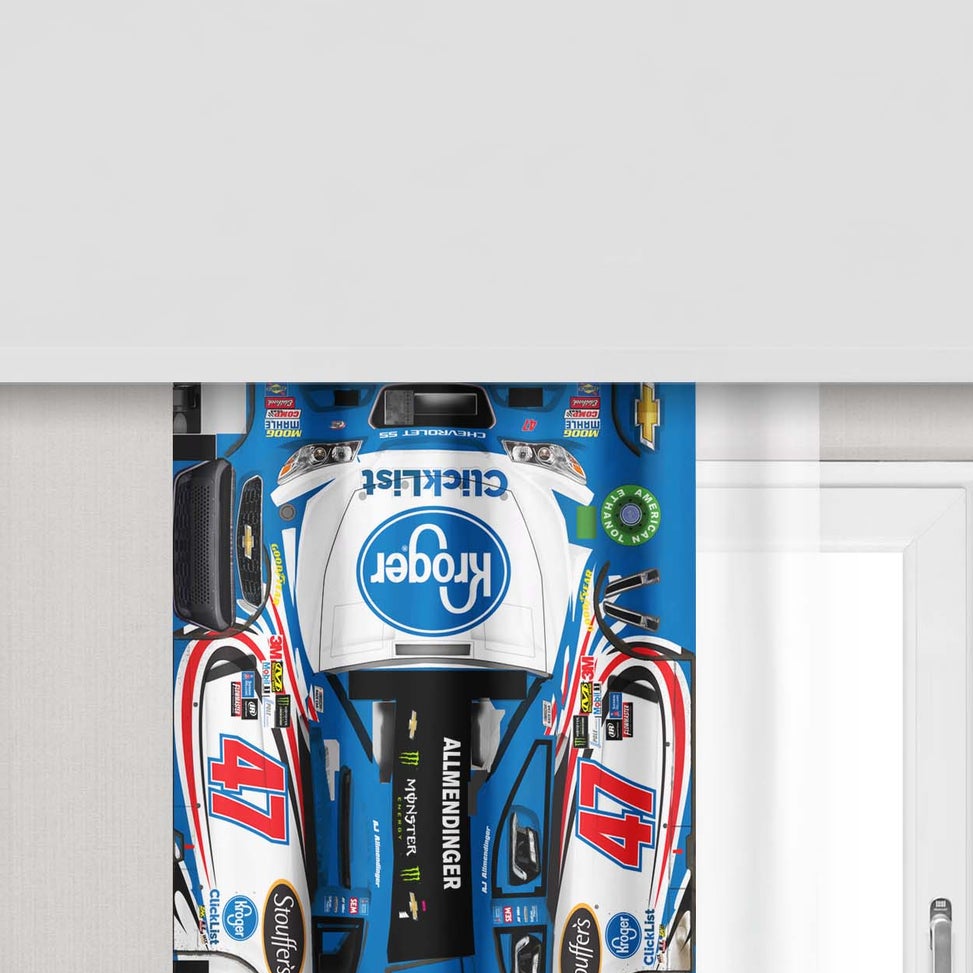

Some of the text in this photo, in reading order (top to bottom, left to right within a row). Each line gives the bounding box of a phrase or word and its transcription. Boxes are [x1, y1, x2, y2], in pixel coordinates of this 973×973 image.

[266, 421, 299, 429] MAHLE
[266, 429, 302, 437] MOOG
[379, 430, 486, 439] CHEVROLET SS
[522, 419, 537, 432] 47
[566, 421, 599, 429] MAHLE
[361, 469, 508, 497] ClickList
[604, 489, 659, 543] AMERICAN ETHANOL
[371, 523, 491, 614] Kroger
[270, 635, 282, 659] 3M
[582, 657, 594, 680] 3M
[208, 733, 289, 845] 47
[404, 779, 418, 857] MONSTER
[442, 737, 461, 890] ALLMENDINGER
[575, 757, 656, 872] 47
[210, 889, 220, 945] ClickList
[226, 900, 252, 938] Kroger
[613, 916, 637, 953] Kroger
[643, 909, 656, 965] ClickList
